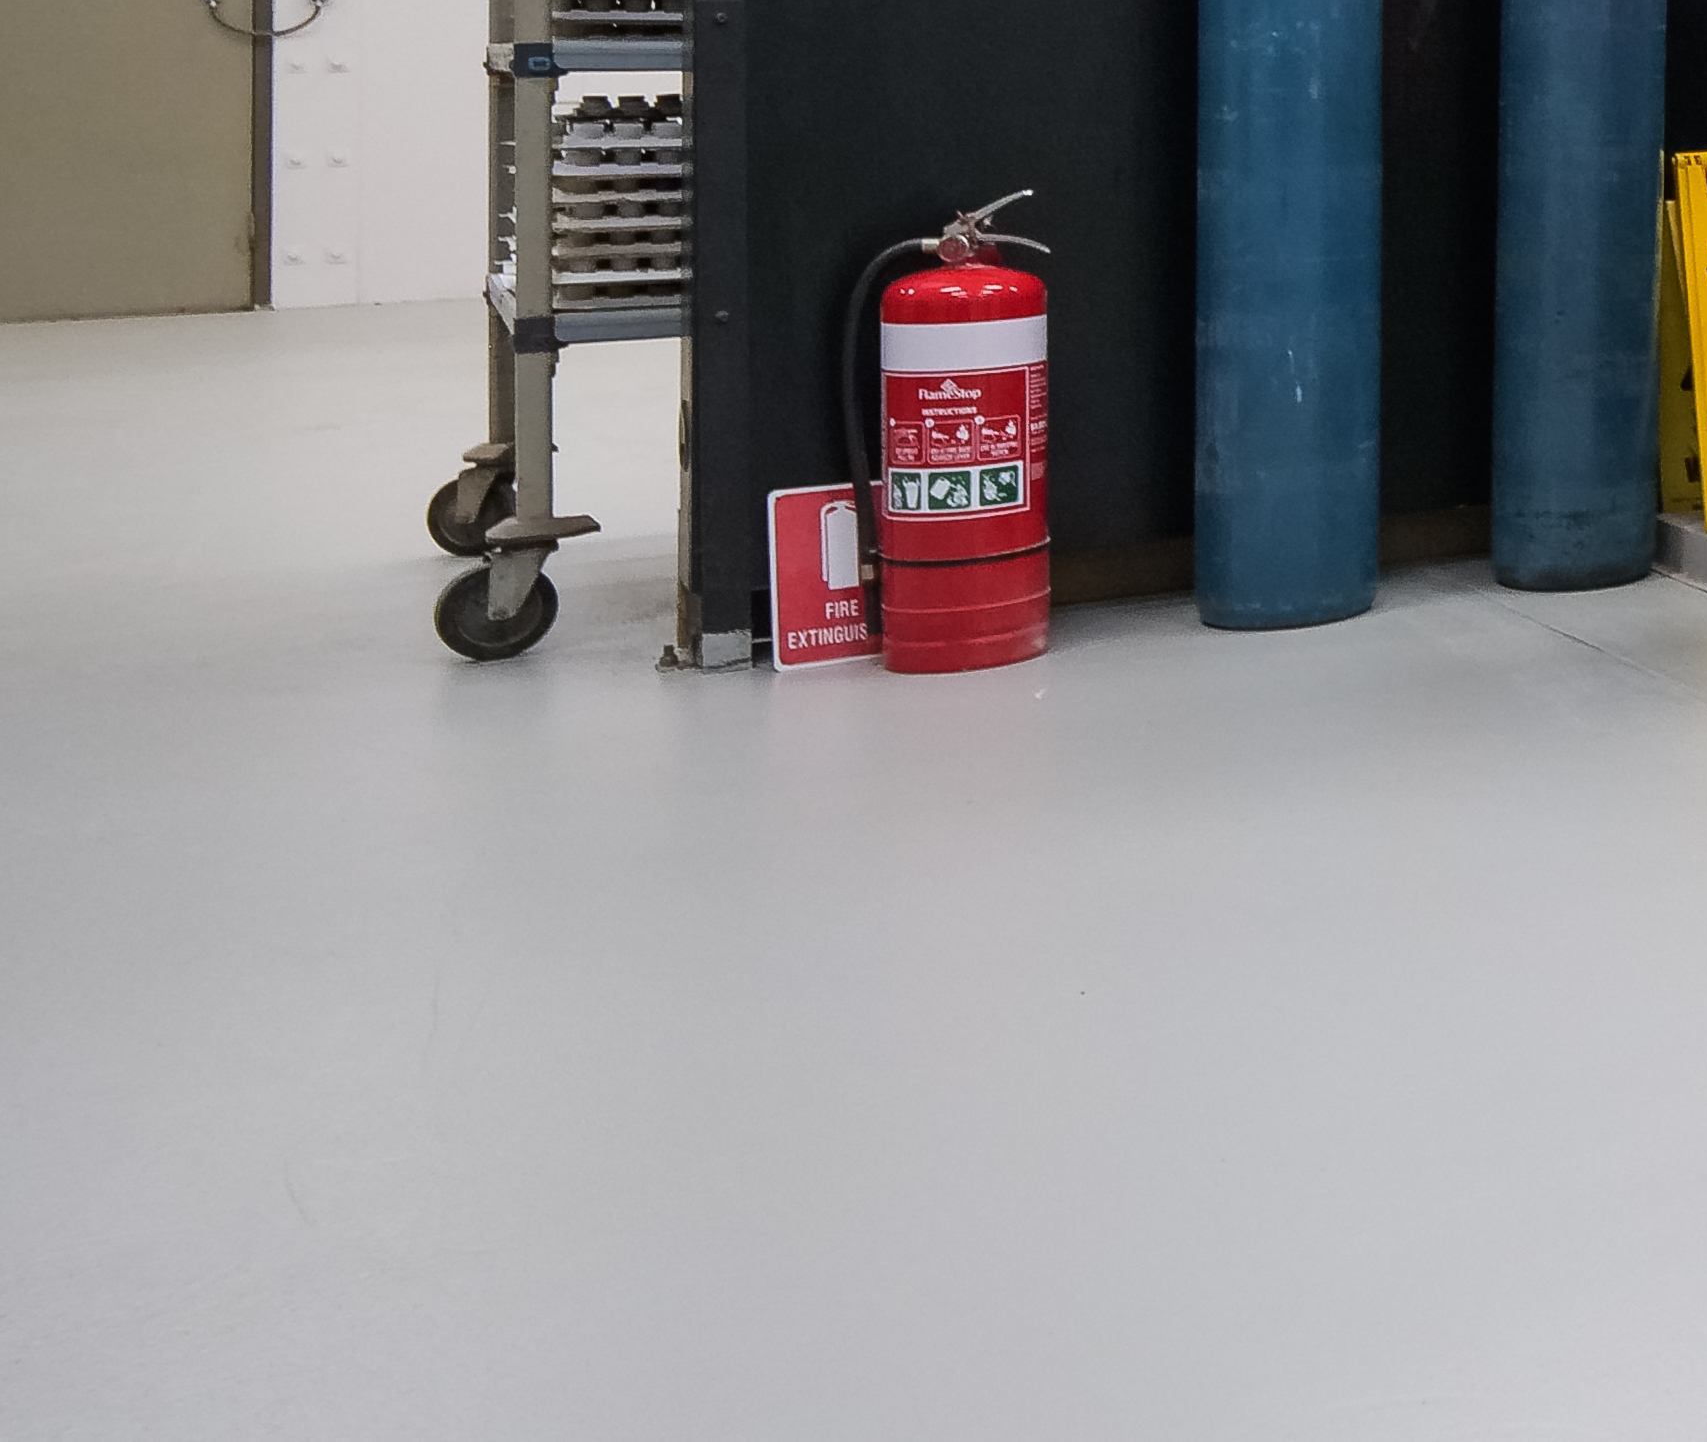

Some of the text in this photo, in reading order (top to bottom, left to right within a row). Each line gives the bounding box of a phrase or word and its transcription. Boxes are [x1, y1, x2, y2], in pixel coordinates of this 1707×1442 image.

[918, 388, 982, 401] FlameStop
[825, 598, 860, 620] FIRE
[787, 622, 868, 650] EXTINGUIS
